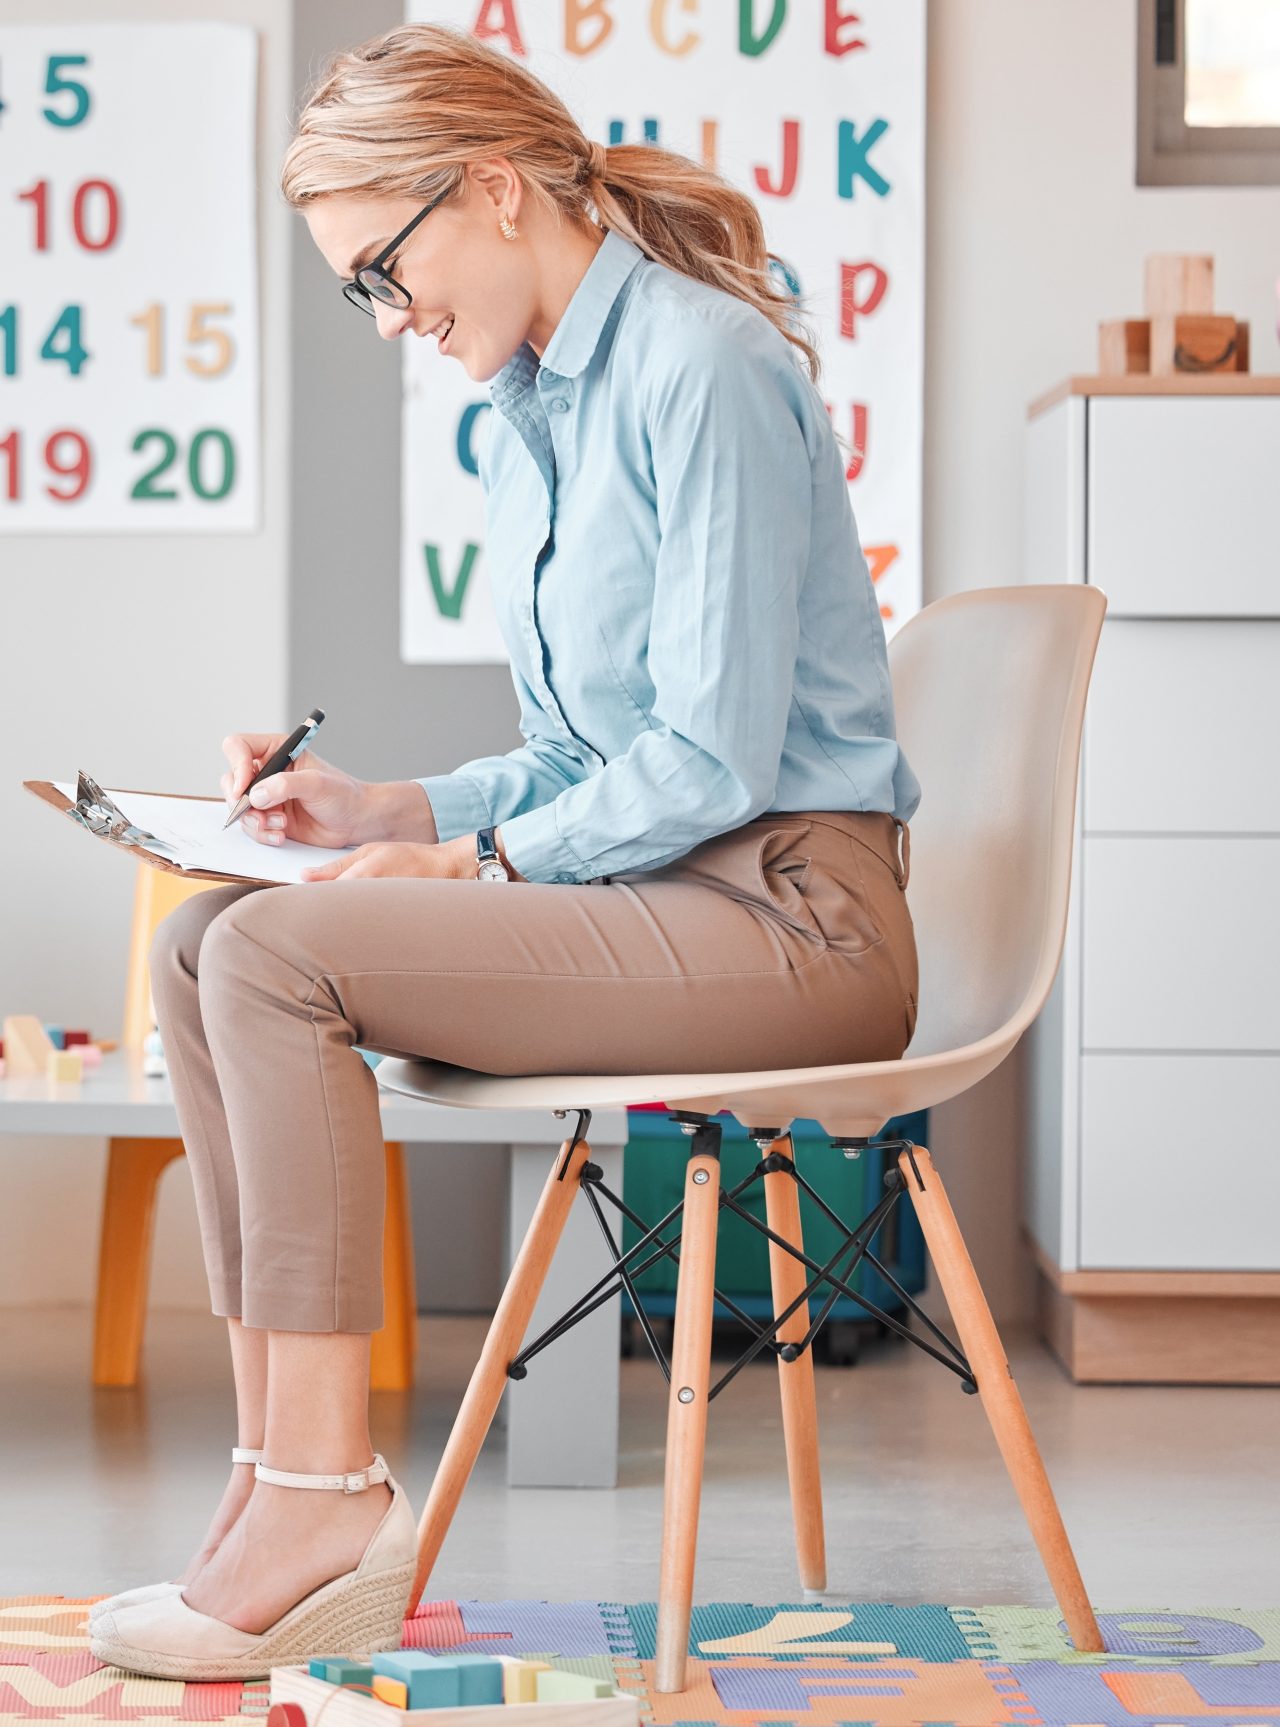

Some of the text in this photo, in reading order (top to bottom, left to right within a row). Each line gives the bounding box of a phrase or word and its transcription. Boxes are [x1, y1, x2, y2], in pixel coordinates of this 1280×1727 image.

[470, 0, 866, 57] A B C D E
[42, 54, 91, 129] 5
[753, 119, 801, 198] J
[837, 118, 891, 201] K
[18, 178, 121, 253] 10
[840, 261, 889, 340] P
[133, 304, 233, 377] 15
[131, 428, 235, 502] 20
[424, 543, 478, 620] V
[708, 1667, 917, 1711] F
[1099, 1672, 1280, 1716] L
